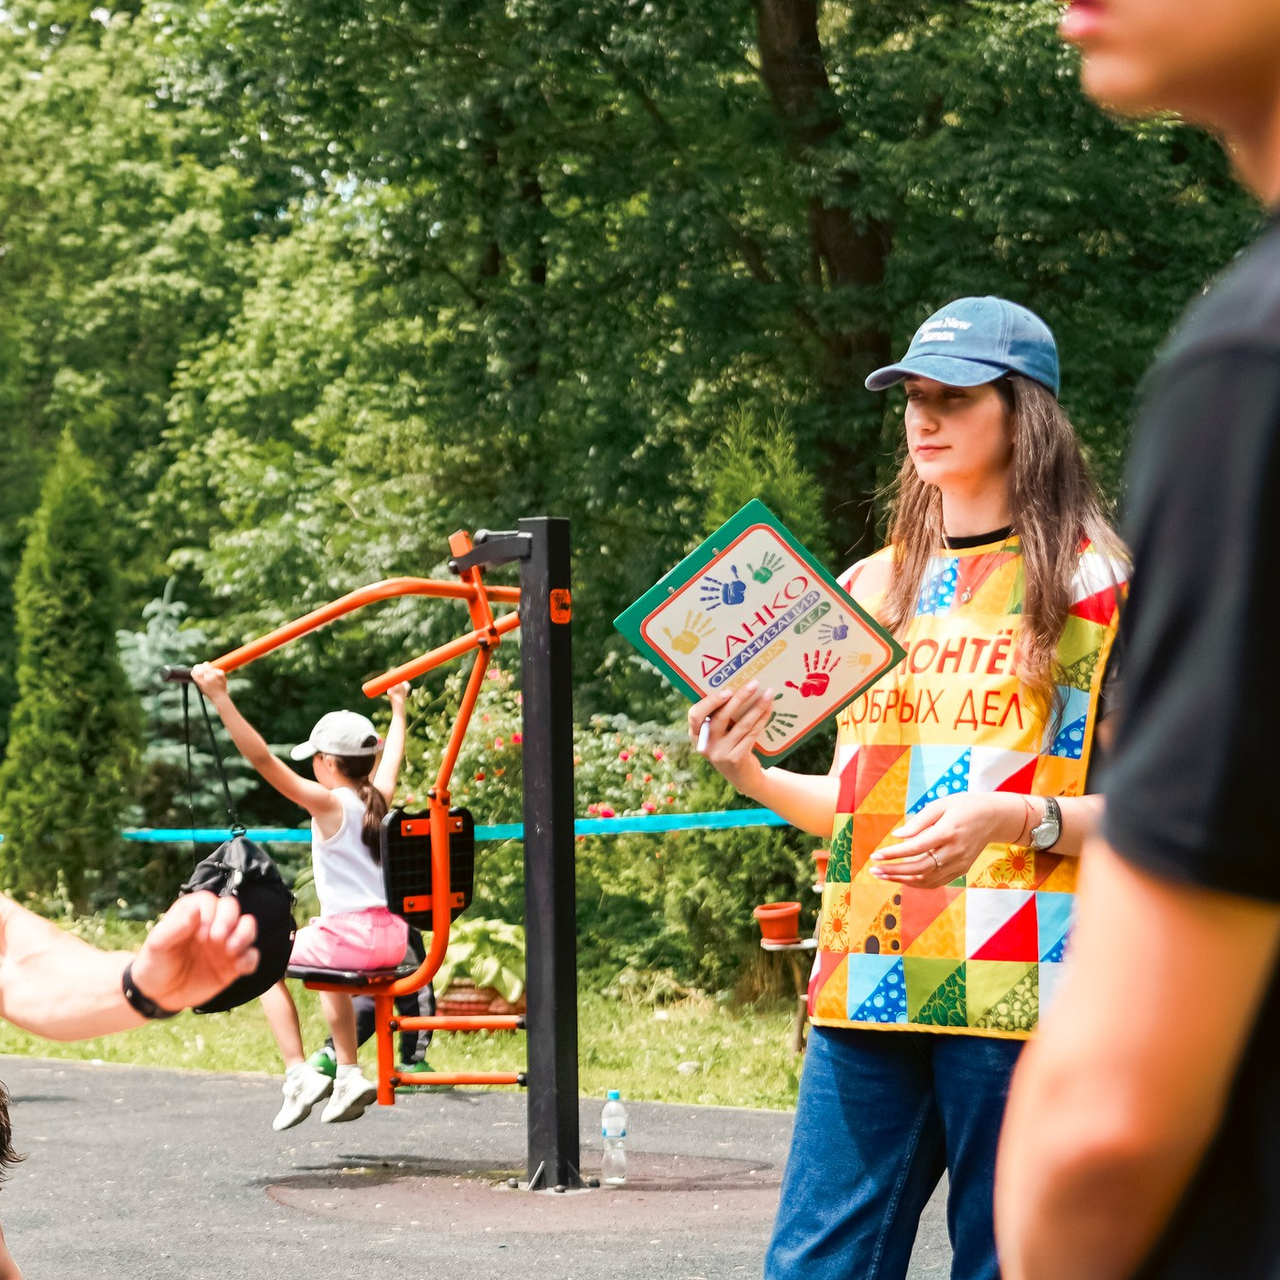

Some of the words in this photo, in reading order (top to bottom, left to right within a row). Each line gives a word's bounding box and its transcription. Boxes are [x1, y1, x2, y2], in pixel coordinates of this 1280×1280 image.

[701, 576, 808, 678] ДАНКО
[711, 591, 818, 687] ОРГАНИЗАЦИЯ
[799, 603, 829, 634] ДЕЛ
[953, 689, 1024, 731] ДЕЛ
